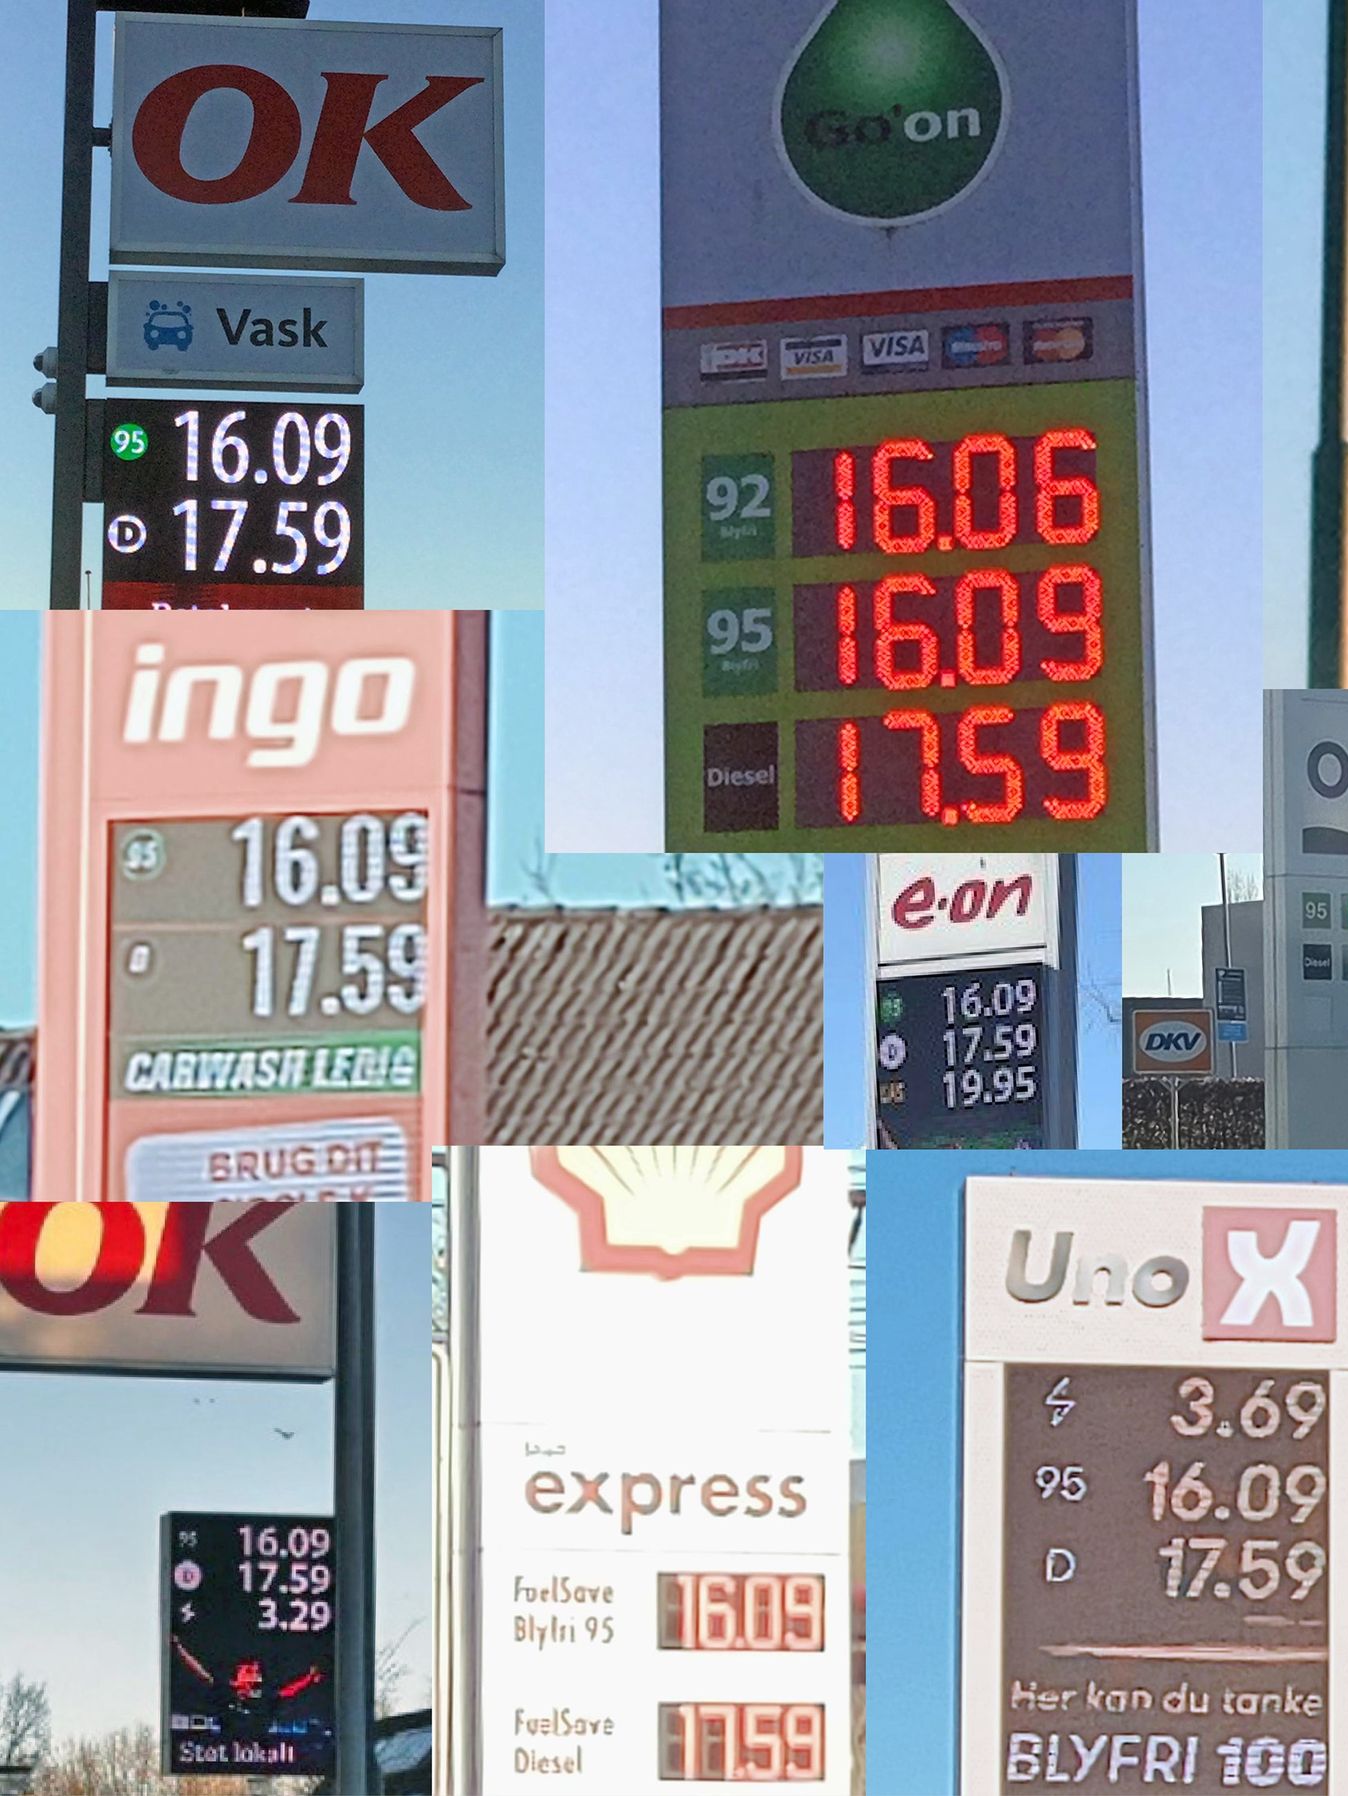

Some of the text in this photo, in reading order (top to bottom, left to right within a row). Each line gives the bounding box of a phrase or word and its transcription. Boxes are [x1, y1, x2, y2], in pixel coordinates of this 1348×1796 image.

[132, 64, 484, 211] OK
[216, 307, 328, 347] Vask
[871, 335, 926, 358] VISA
[794, 350, 834, 364] VISA
[114, 430, 145, 454] 95
[173, 410, 350, 485] 16.09
[706, 474, 772, 521] 92
[835, 427, 1101, 555] 16.06
[118, 524, 135, 543] D
[173, 499, 350, 576] 17.59
[707, 607, 773, 655] 95
[836, 562, 1103, 691] 16.09
[123, 643, 416, 768] ingo
[706, 764, 775, 788] Diesel
[838, 700, 1107, 825] 17.59
[231, 813, 429, 907] 16.09
[1304, 901, 1328, 920] 95
[242, 924, 427, 1017] 17.59
[942, 979, 1037, 1025] 16.09
[943, 1024, 1037, 1067] 17.59
[1145, 1031, 1202, 1052] DKV
[943, 1066, 1037, 1109] 19.95
[208, 1146, 316, 1182] BRUG
[0, 1202, 302, 1325] OK
[1005, 1220, 1321, 1327] Uno X
[1170, 1376, 1327, 1439] 3.69
[525, 1470, 808, 1536] express
[1035, 1466, 1088, 1502] 95
[1143, 1459, 1327, 1524] 16.09
[178, 1530, 199, 1548] 95
[238, 1525, 331, 1559] 16.09
[238, 1560, 331, 1595] 17.59
[1046, 1549, 1077, 1583] D
[1158, 1537, 1327, 1601] 17.59
[514, 1574, 614, 1604] FuelSave
[258, 1598, 331, 1632] 3.29
[584, 1615, 615, 1644] 95
[676, 1575, 824, 1651] 16.09
[1087, 1680, 1153, 1713] kan
[1161, 1681, 1209, 1714] du
[1222, 1684, 1324, 1717] tanke
[514, 1706, 615, 1736] FuelSave
[678, 1703, 823, 1780] 17.59
[514, 1744, 583, 1774] Diesel
[1006, 1732, 1327, 1787] BLYFRI 100
